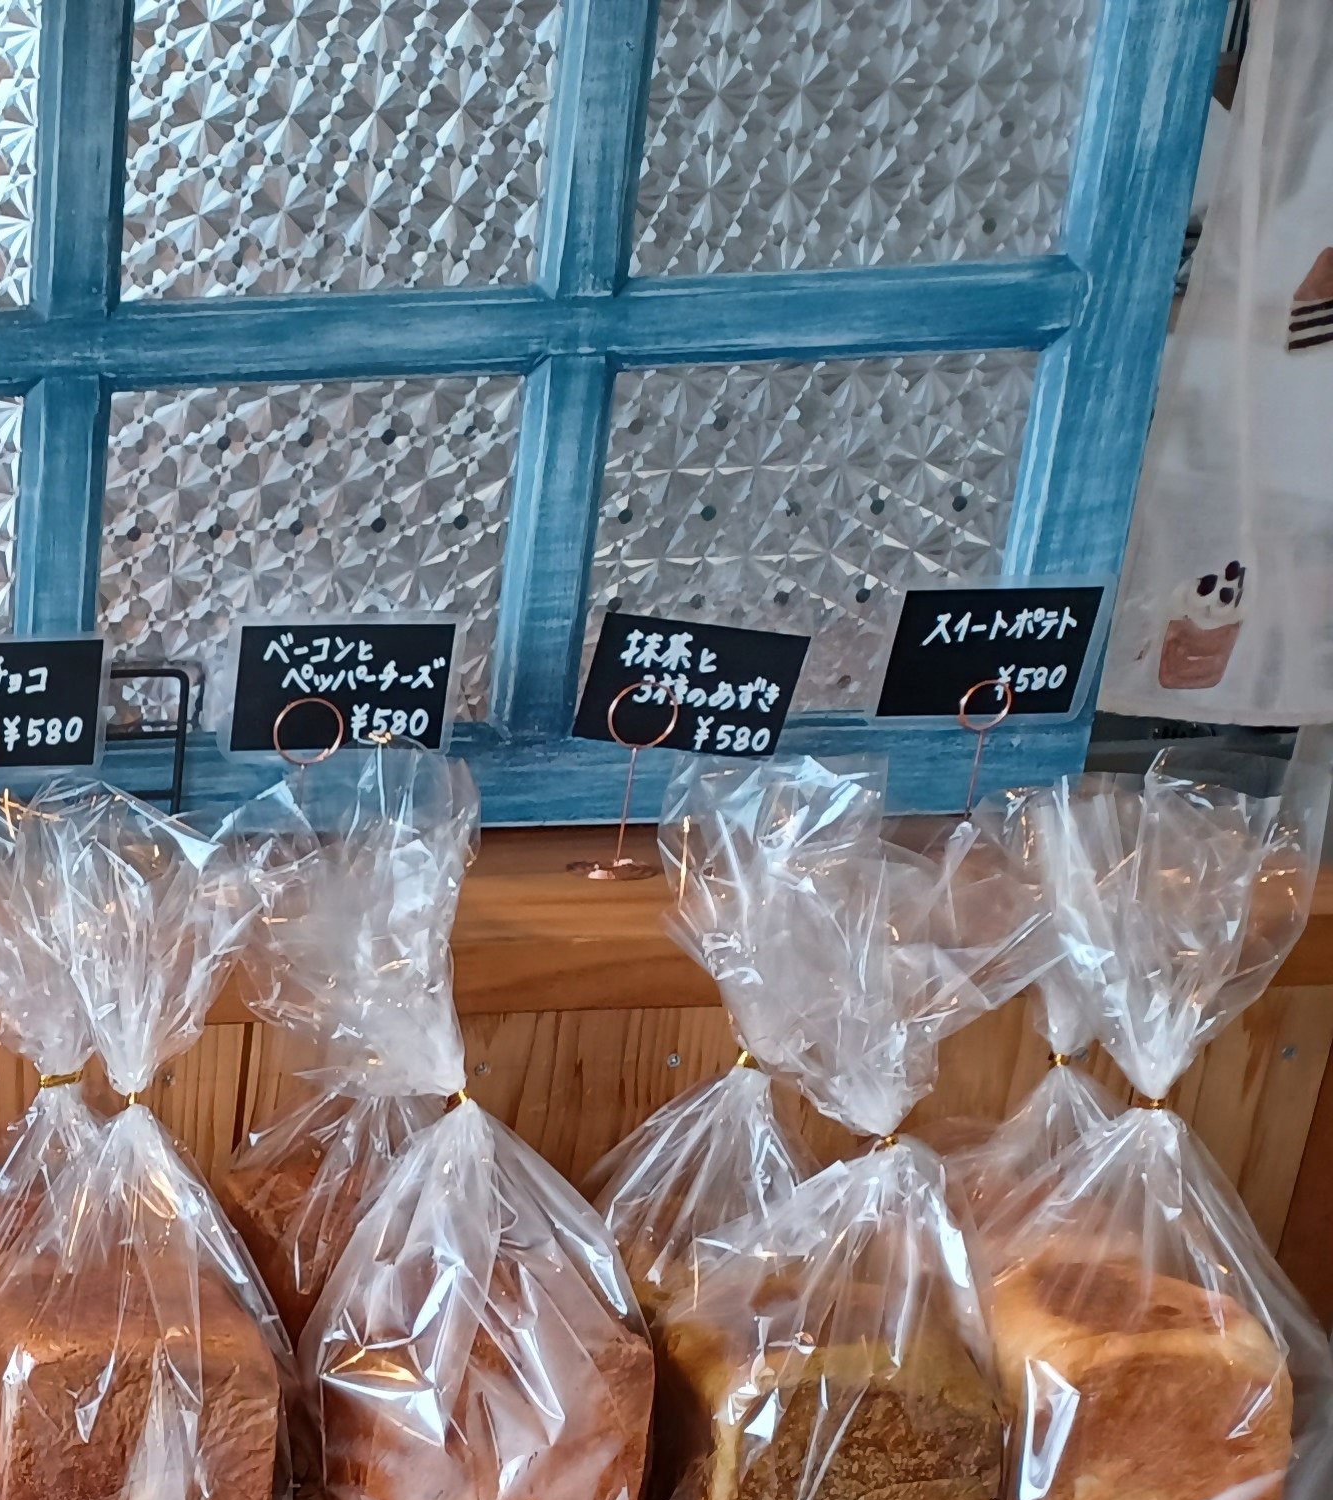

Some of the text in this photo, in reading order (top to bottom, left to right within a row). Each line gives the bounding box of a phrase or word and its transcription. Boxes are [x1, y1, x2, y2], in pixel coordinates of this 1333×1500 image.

[919, 606, 1078, 647] スイートポテト
[262, 631, 374, 664] ベーコンと
[620, 628, 718, 674] 抹茶と
[280, 656, 446, 694] ペッパーチーズ
[994, 663, 1068, 701] ¥580
[2, 714, 84, 752] ¥580
[350, 702, 430, 741] ¥580
[693, 715, 771, 752] ¥580
